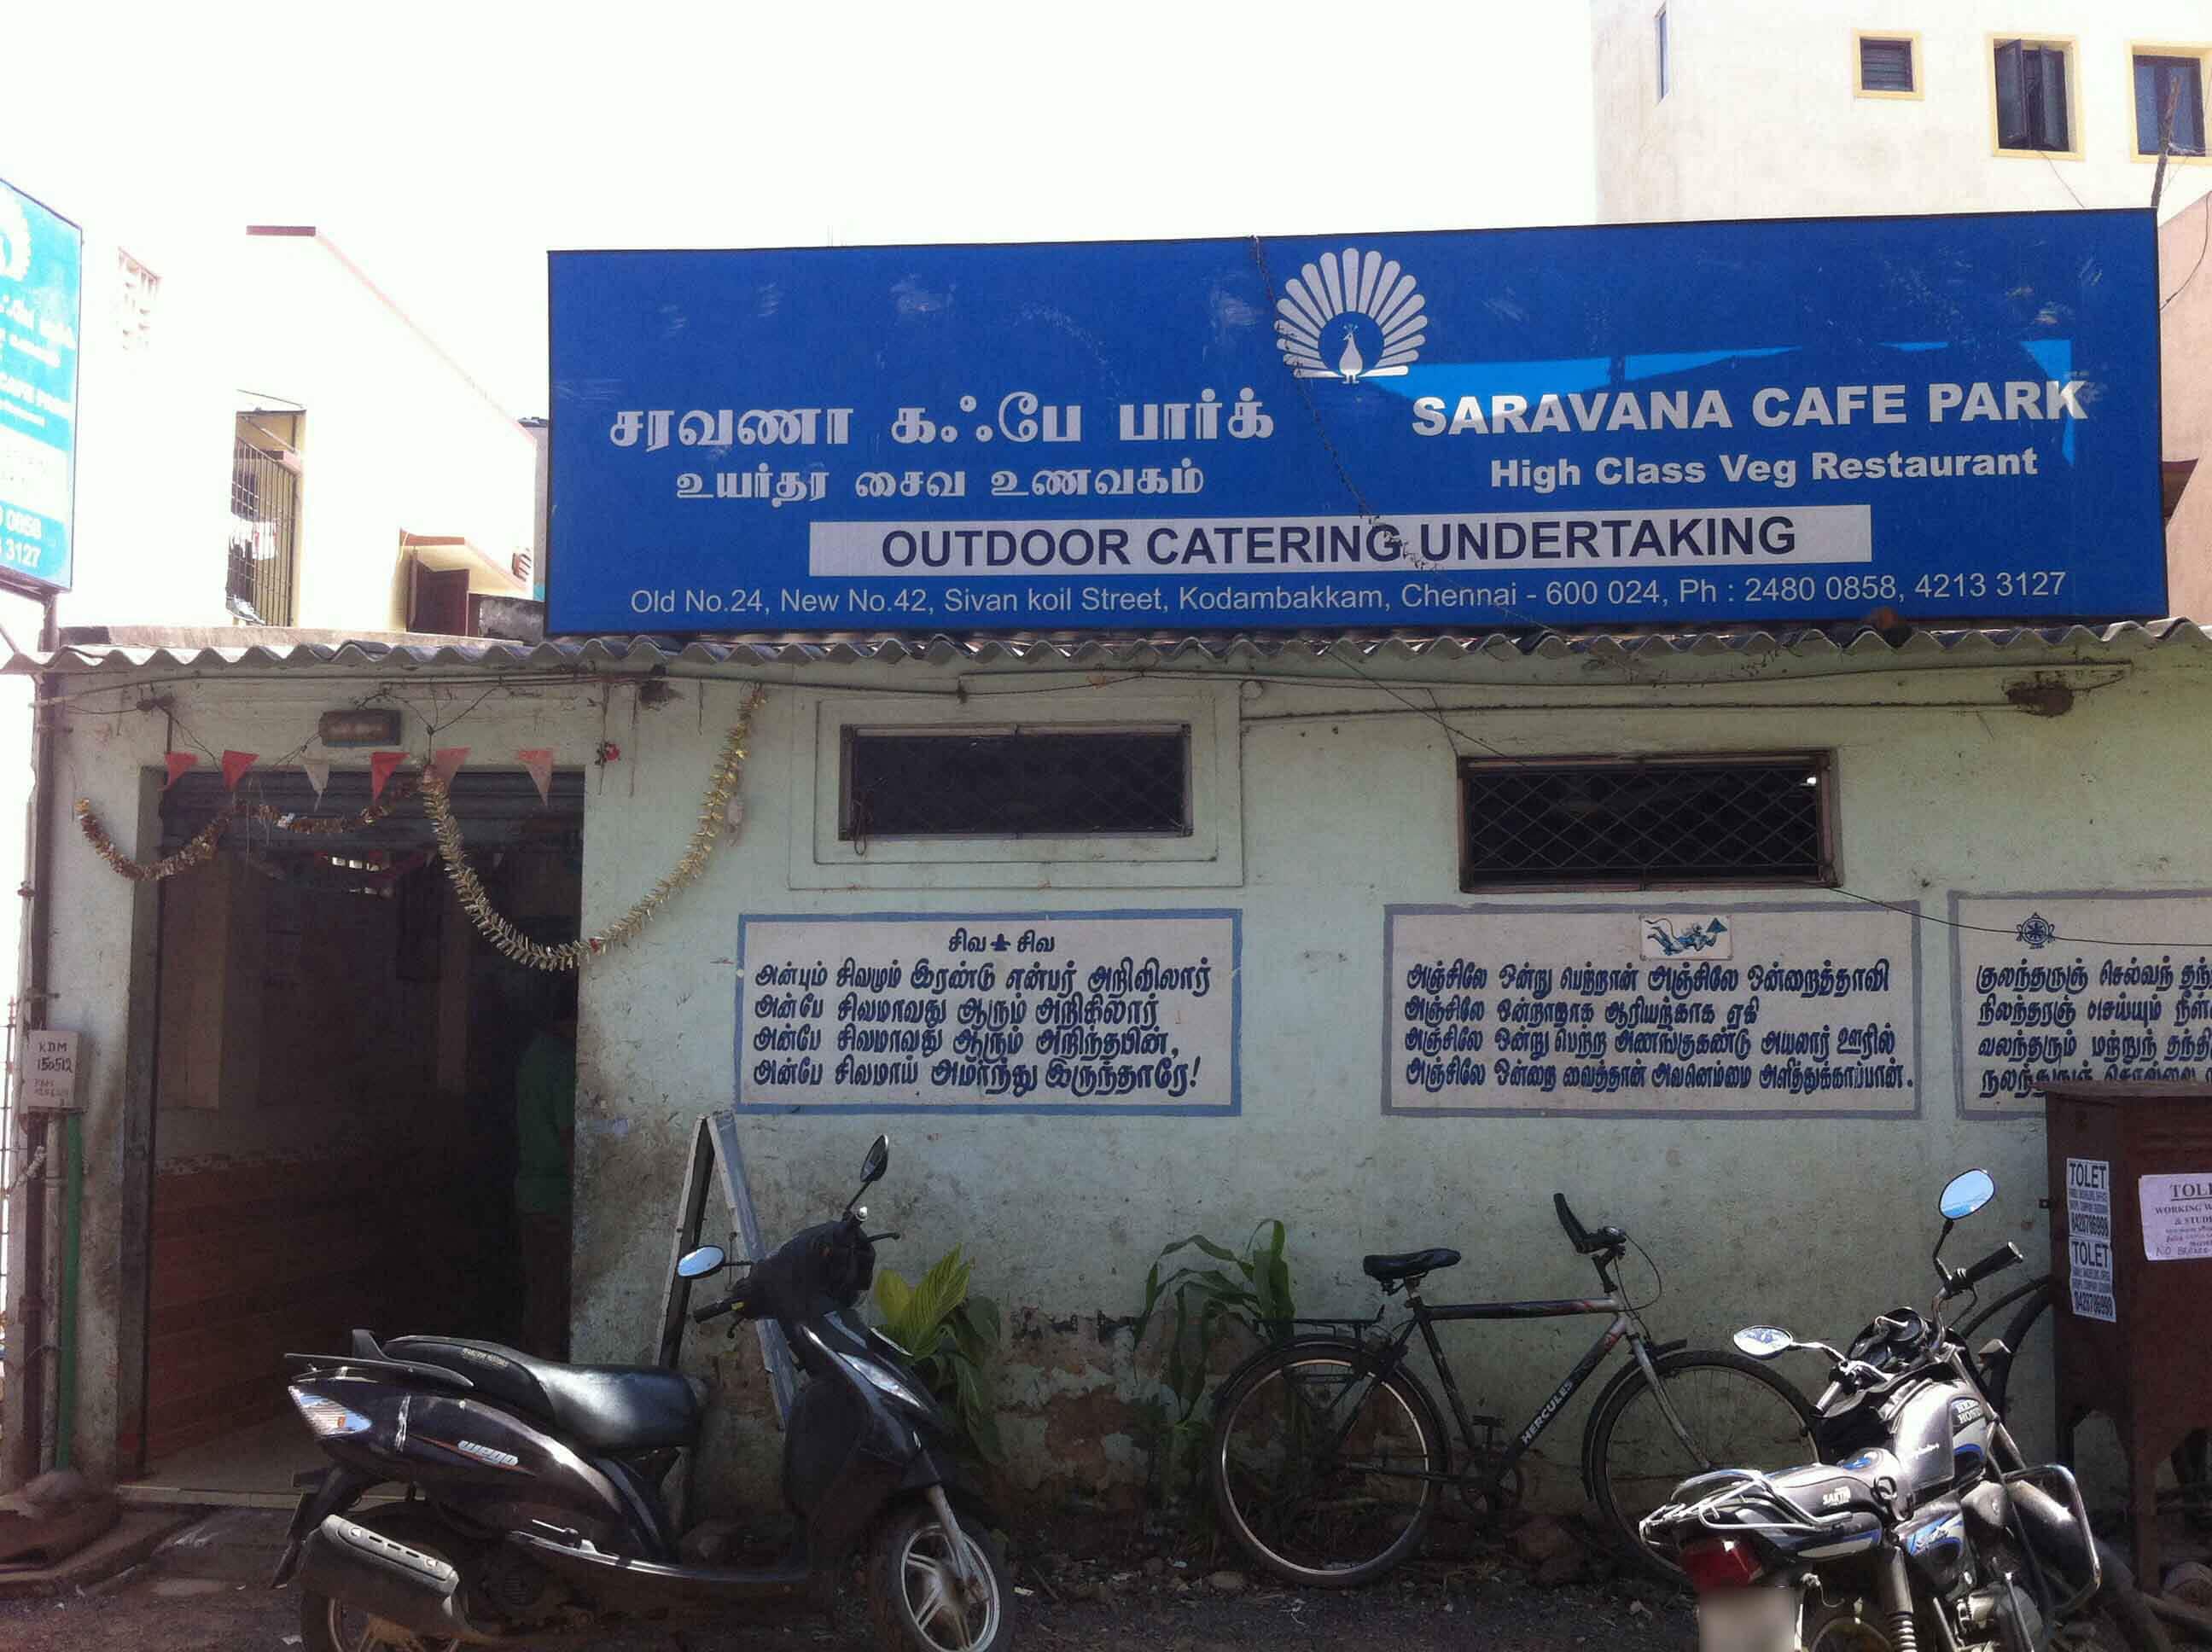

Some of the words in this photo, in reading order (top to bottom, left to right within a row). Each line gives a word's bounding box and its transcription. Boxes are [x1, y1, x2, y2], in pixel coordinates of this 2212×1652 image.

[609, 407, 854, 453] சரவணா
[1119, 386, 1274, 440] பார்க்
[1412, 393, 1733, 437] SARAVANA
[1752, 384, 1906, 428] CAFE
[1928, 379, 2088, 422] PARK
[676, 462, 830, 508] உயர்தர
[855, 468, 966, 499] சைவ
[990, 457, 1204, 498] உணவகம்
[1491, 456, 1580, 493] High
[1595, 455, 1706, 486] Class
[1720, 452, 1797, 488] Veg
[1812, 446, 2039, 481] Restaurant
[882, 528, 1130, 568] OUTDOOR
[1146, 522, 1402, 567] CATERING
[1420, 515, 1796, 563] UNDERTAKING
[631, 588, 675, 614] Old
[684, 588, 771, 616] No.24,
[780, 587, 841, 613] New
[848, 587, 934, 615] No.42,
[944, 587, 1018, 613] Sivan
[1027, 586, 1073, 613] koil
[1080, 586, 1168, 613] Street,
[1179, 583, 1391, 612] Kodambakkam,
[1400, 581, 1517, 609] Chennai
[1545, 580, 1598, 606] 600
[1607, 579, 1669, 608] 024,
[1679, 579, 1717, 604] Ph
[1744, 577, 1816, 603] 2480
[1825, 575, 1905, 602] 0858,
[1915, 572, 1987, 599] 4213
[1995, 570, 2068, 597] 3127
[948, 927, 986, 952] சிவ
[1016, 928, 1056, 953] சிவ
[754, 959, 829, 992] அன்பும்
[835, 957, 902, 993] சிவமும்
[910, 957, 995, 995] இரண்டு
[1005, 960, 1078, 998] என்பர்
[754, 992, 824, 1019] அன்பே
[753, 1022, 821, 1052] அன்பே
[753, 1056, 824, 1086] அன்பே
[835, 1054, 918, 1086] சிவமாய்
[2069, 1162, 2107, 1190] TOLET
[2071, 1241, 2109, 1269] TOLET
[1521, 1381, 1574, 1445] HERCULES
